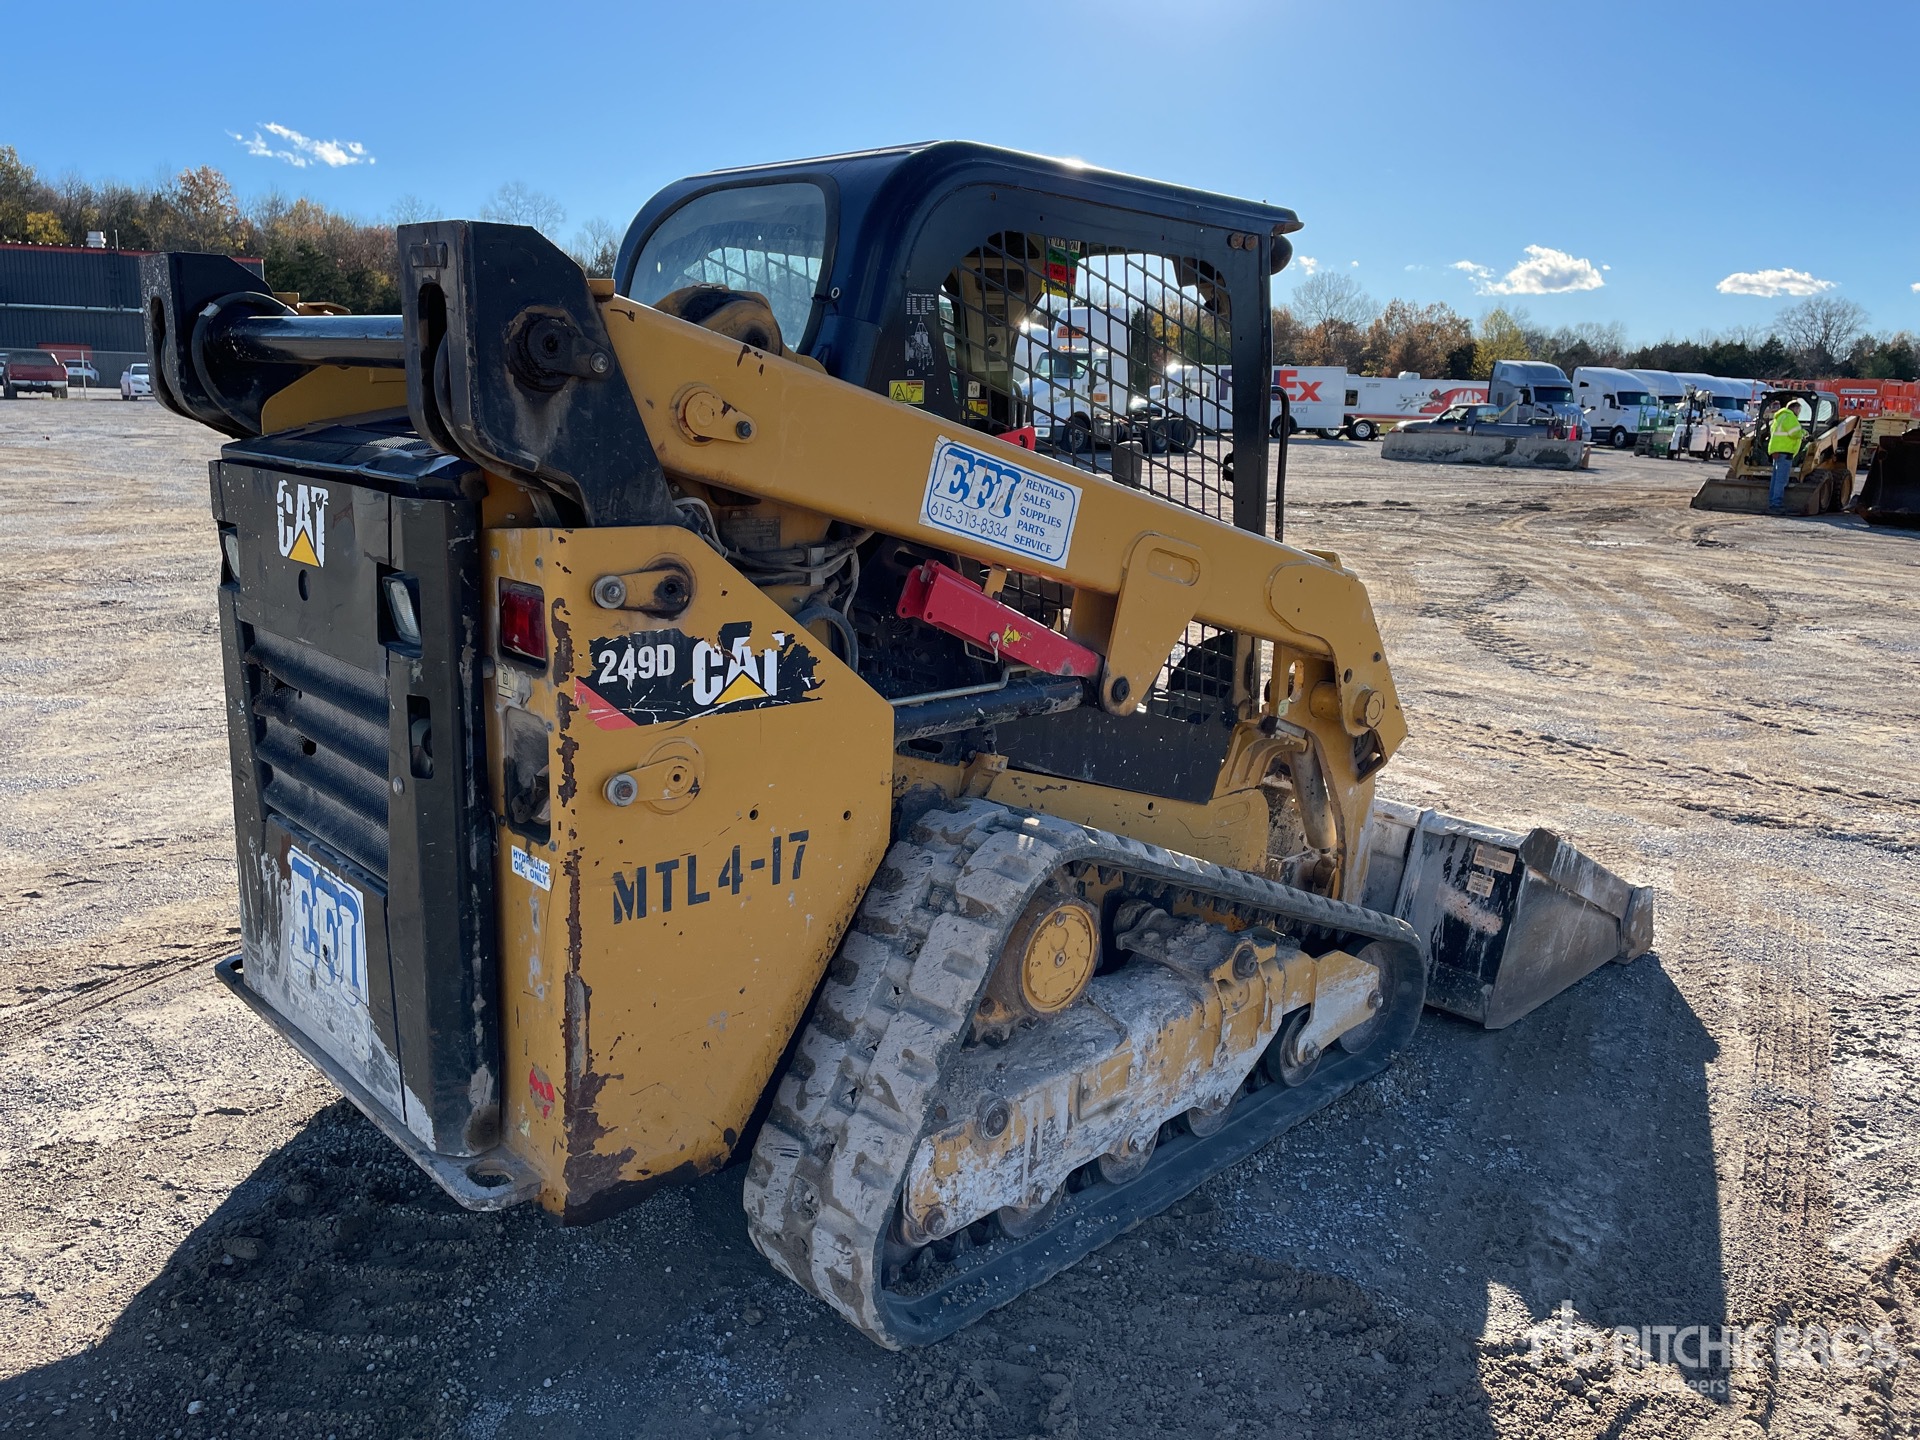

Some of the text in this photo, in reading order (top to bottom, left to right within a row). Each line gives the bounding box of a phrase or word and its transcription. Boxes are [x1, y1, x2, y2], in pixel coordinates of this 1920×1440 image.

[932, 448, 1021, 519] EFI
[1025, 478, 1065, 501] RENTALS
[1023, 492, 1051, 510] SALES
[276, 479, 329, 568] CAT
[930, 501, 1008, 539] 615-313-8334
[1017, 519, 1046, 537] PARTS
[1020, 506, 1062, 528] SUPPLIES
[1013, 533, 1053, 554] SERVICE
[598, 631, 785, 706] 249D CAT
[530, 868, 548, 885] ONLY
